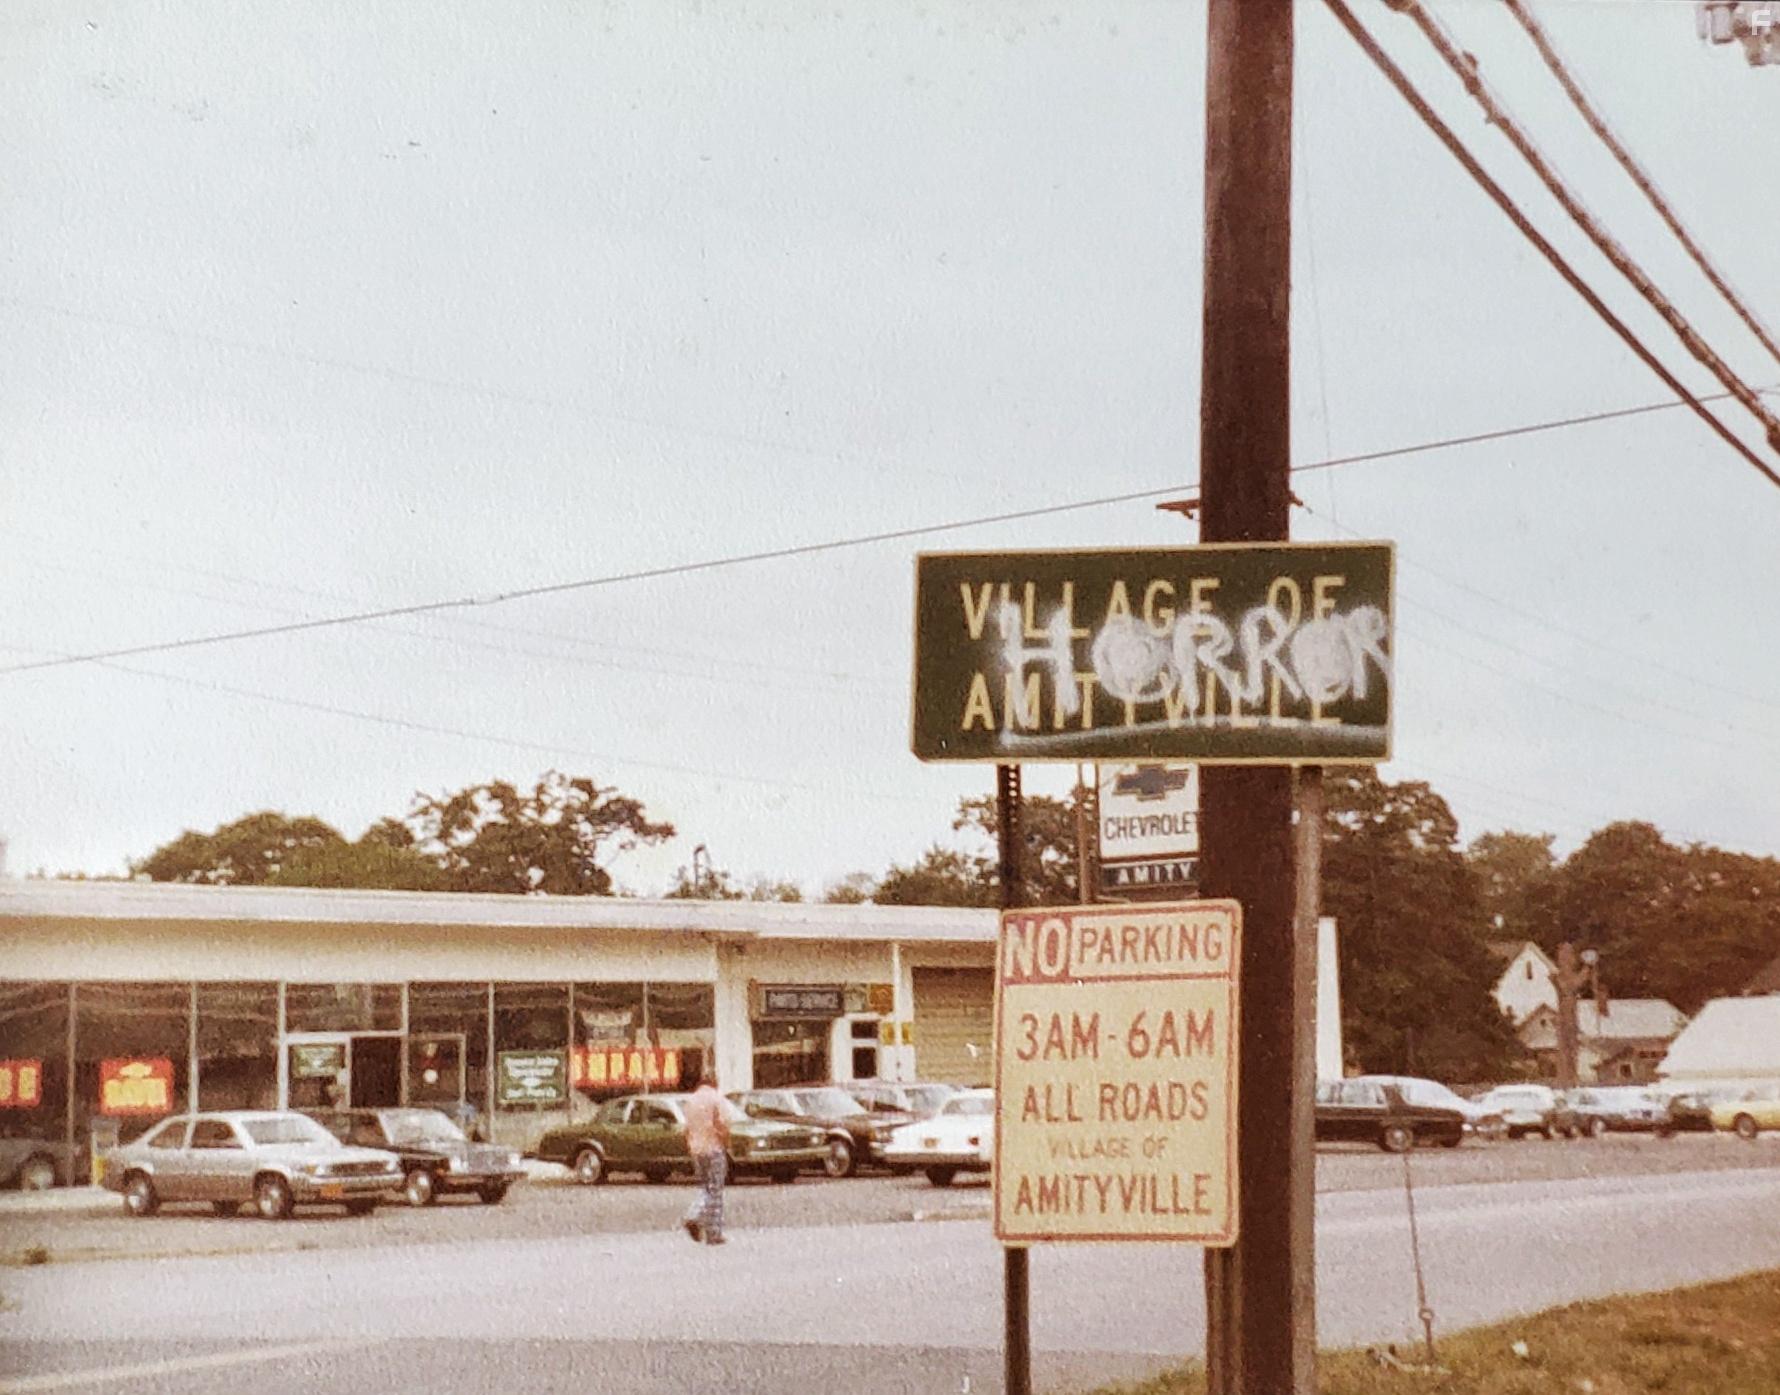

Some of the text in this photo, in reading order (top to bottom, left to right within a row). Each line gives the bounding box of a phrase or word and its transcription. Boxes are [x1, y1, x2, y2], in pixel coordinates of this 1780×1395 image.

[960, 574, 1346, 640] VILLAGE OF
[996, 602, 1391, 727] HORROR
[1117, 862, 1192, 884] AMITY
[1004, 918, 1224, 978] NO PARKING
[1021, 1080, 1209, 1124] ALL ROADS
[1048, 1134, 1168, 1160] VILLAGE OF
[1014, 1173, 1213, 1216] AMITYVILLE
